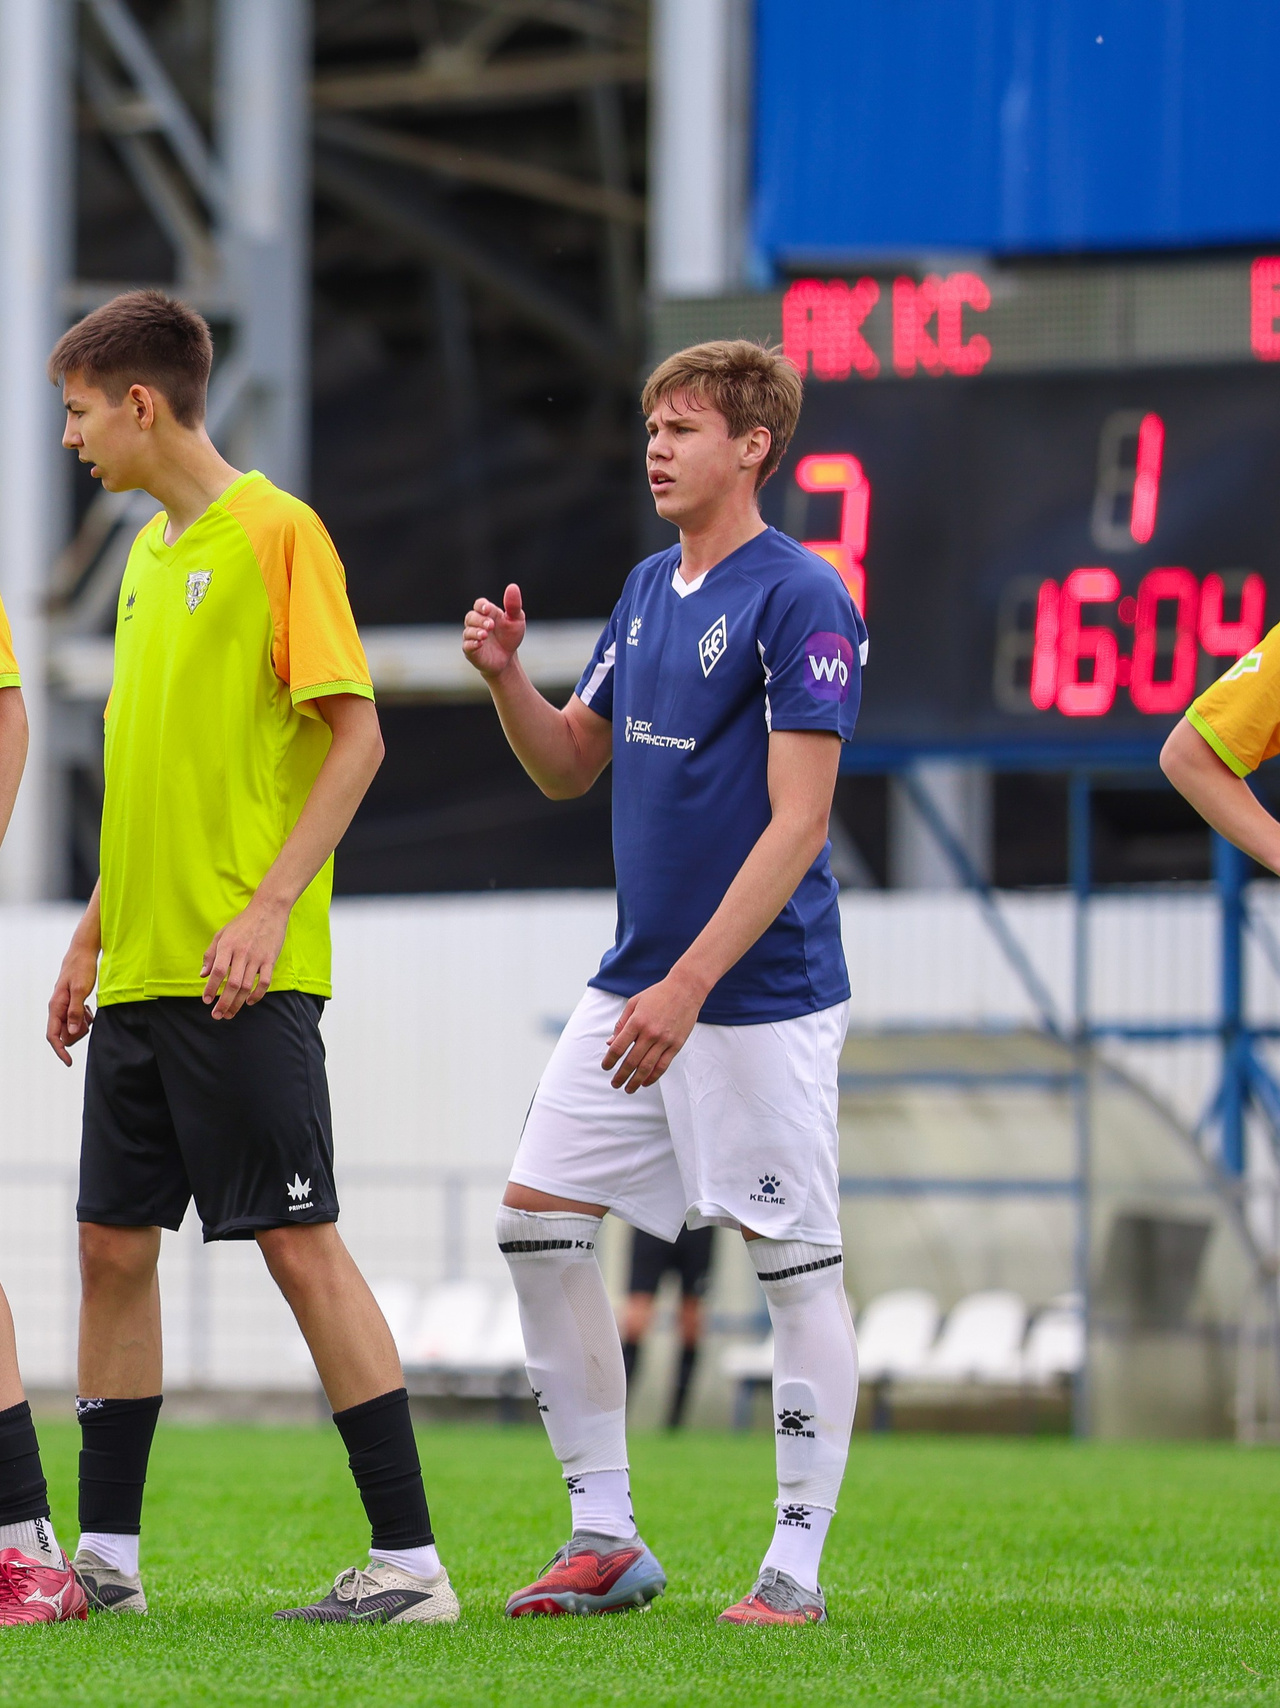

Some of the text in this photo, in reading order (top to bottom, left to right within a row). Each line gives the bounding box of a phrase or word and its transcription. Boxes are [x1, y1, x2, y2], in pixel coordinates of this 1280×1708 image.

[1131, 411, 1165, 544] 1
[1030, 567, 1266, 716] 16:04
[632, 719, 653, 733] ДСК
[632, 731, 696, 751] ТРАНССТРОЙ
[749, 1193, 786, 1205] KELME
[288, 1201, 314, 1212] PRIMERA
[776, 1428, 816, 1439] KELME
[777, 1519, 812, 1531] KELME
